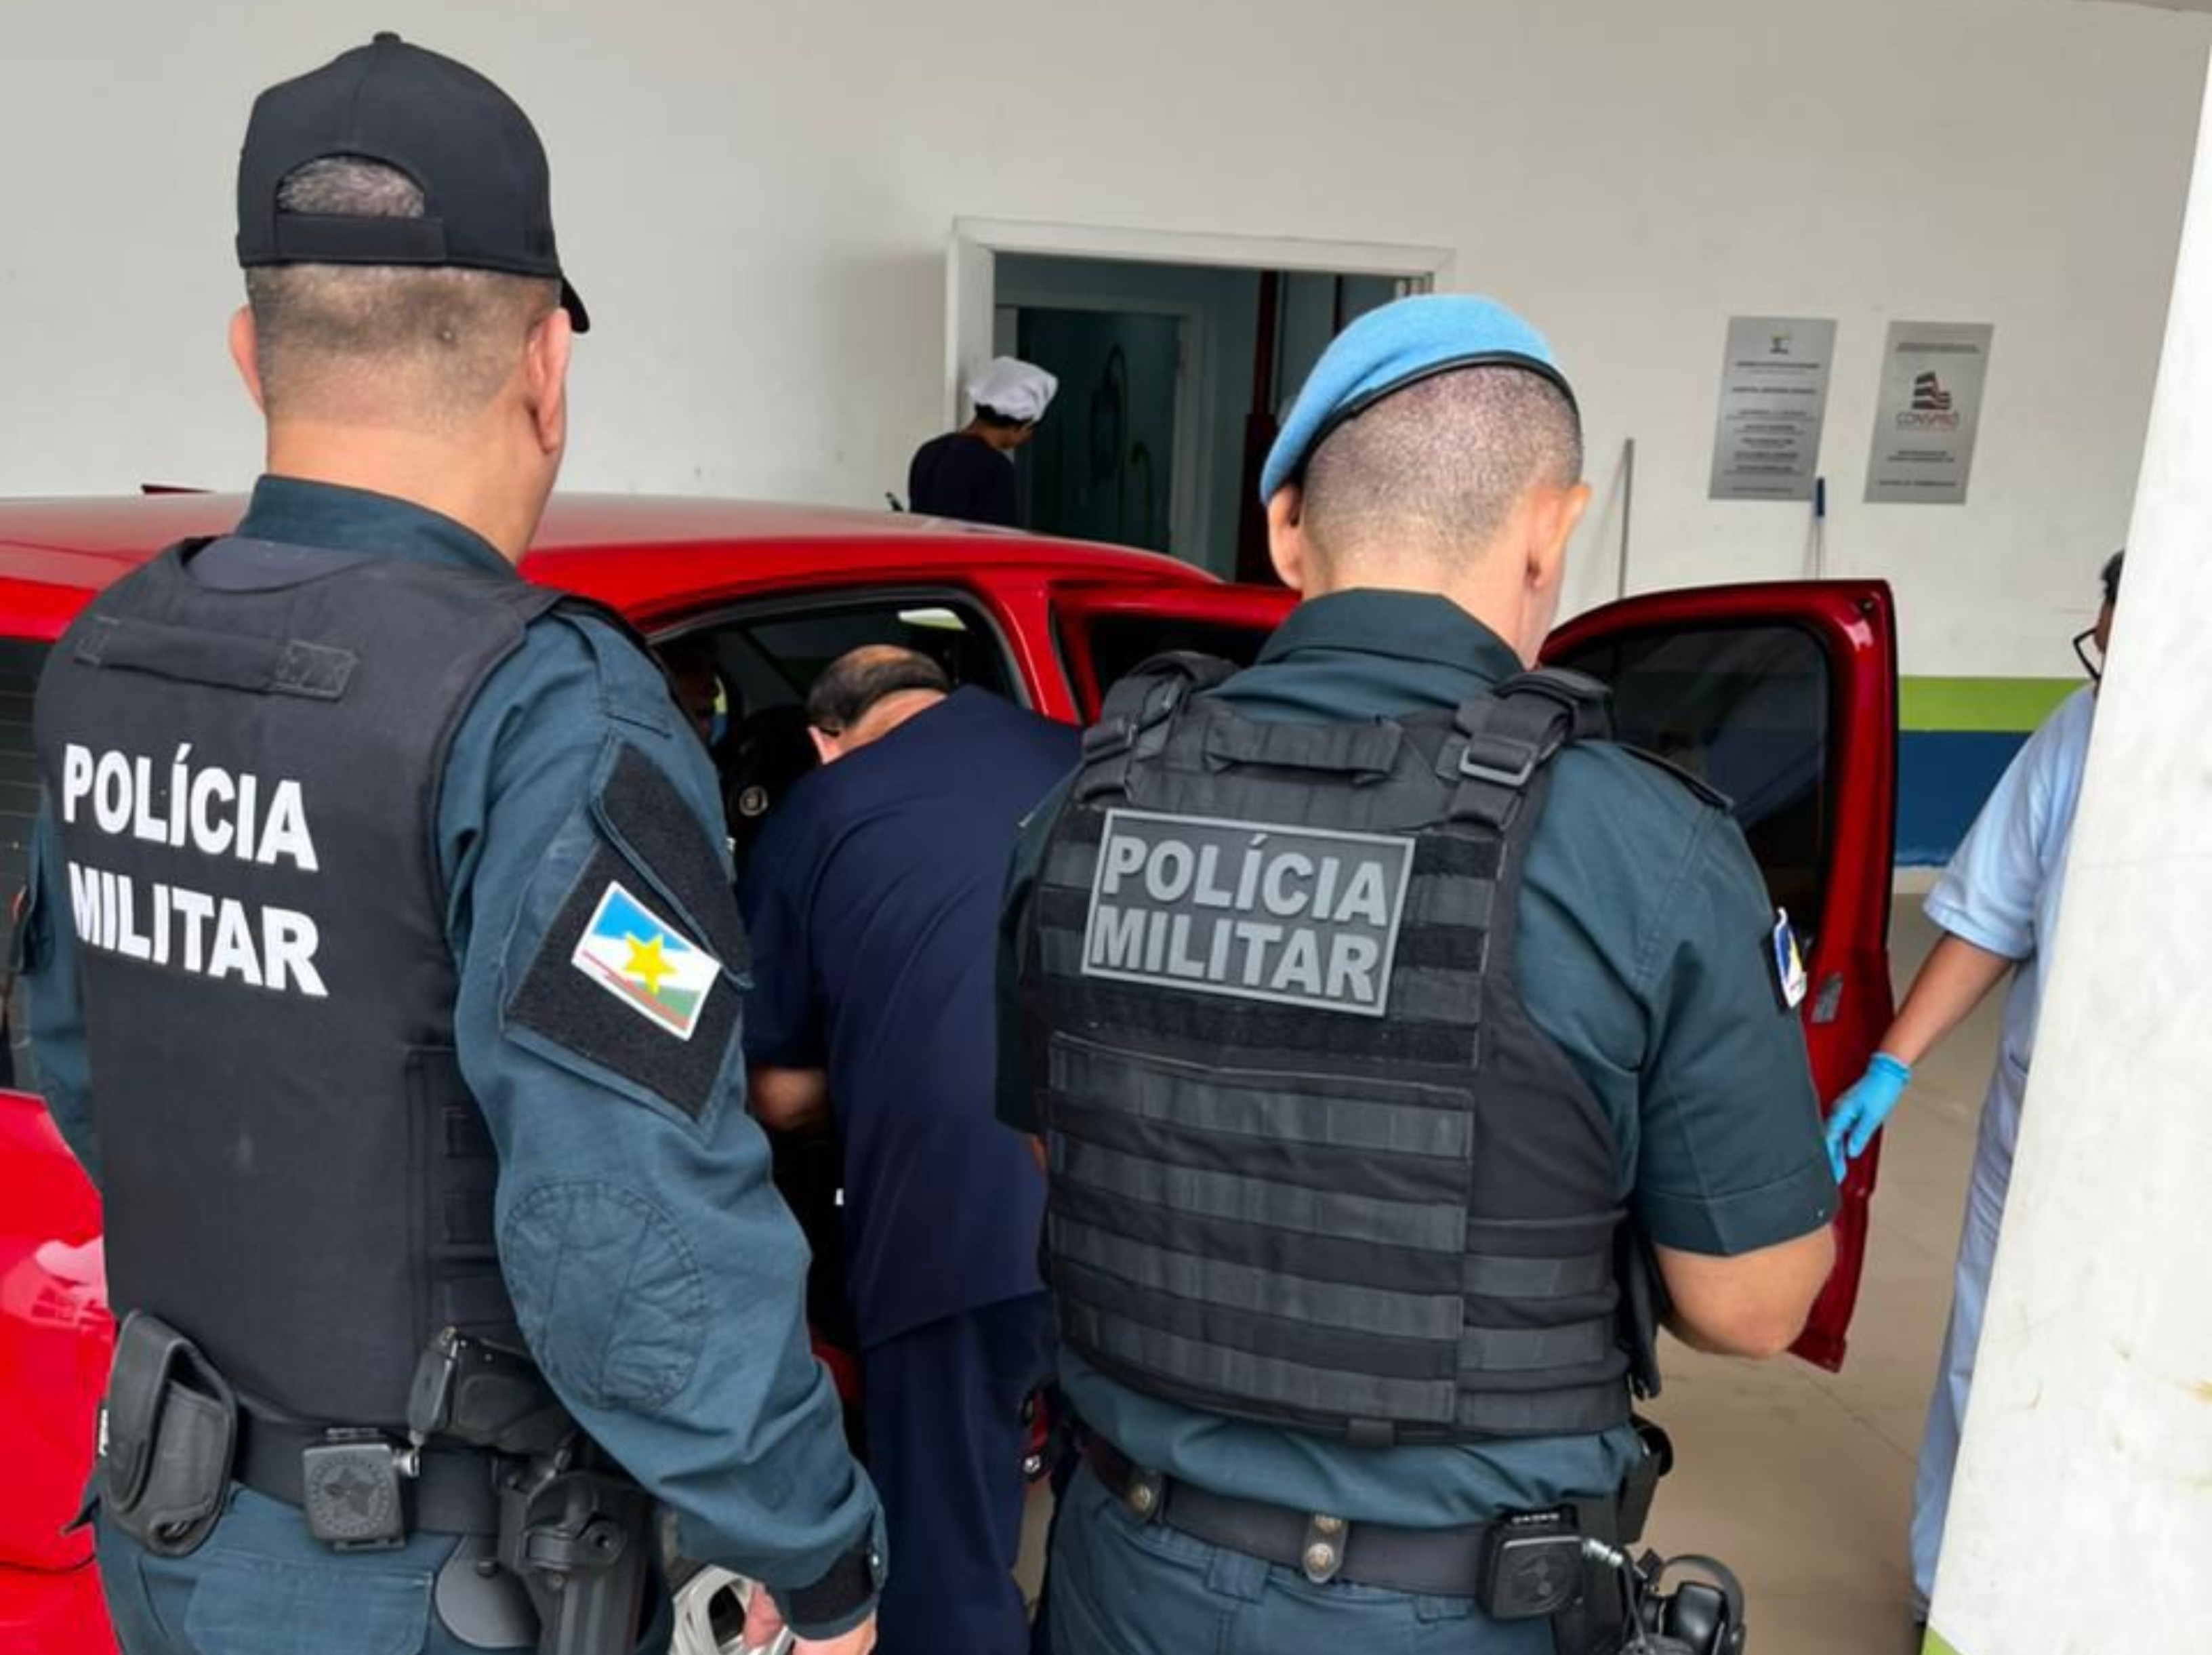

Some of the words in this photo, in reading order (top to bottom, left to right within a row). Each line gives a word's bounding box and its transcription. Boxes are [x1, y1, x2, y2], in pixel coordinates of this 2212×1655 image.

[64, 743, 319, 872] POLÍCIA
[68, 861, 329, 998] MILITAR
[1102, 833, 1387, 927] POLÍCIA
[1090, 903, 1380, 1002] MILITAR
